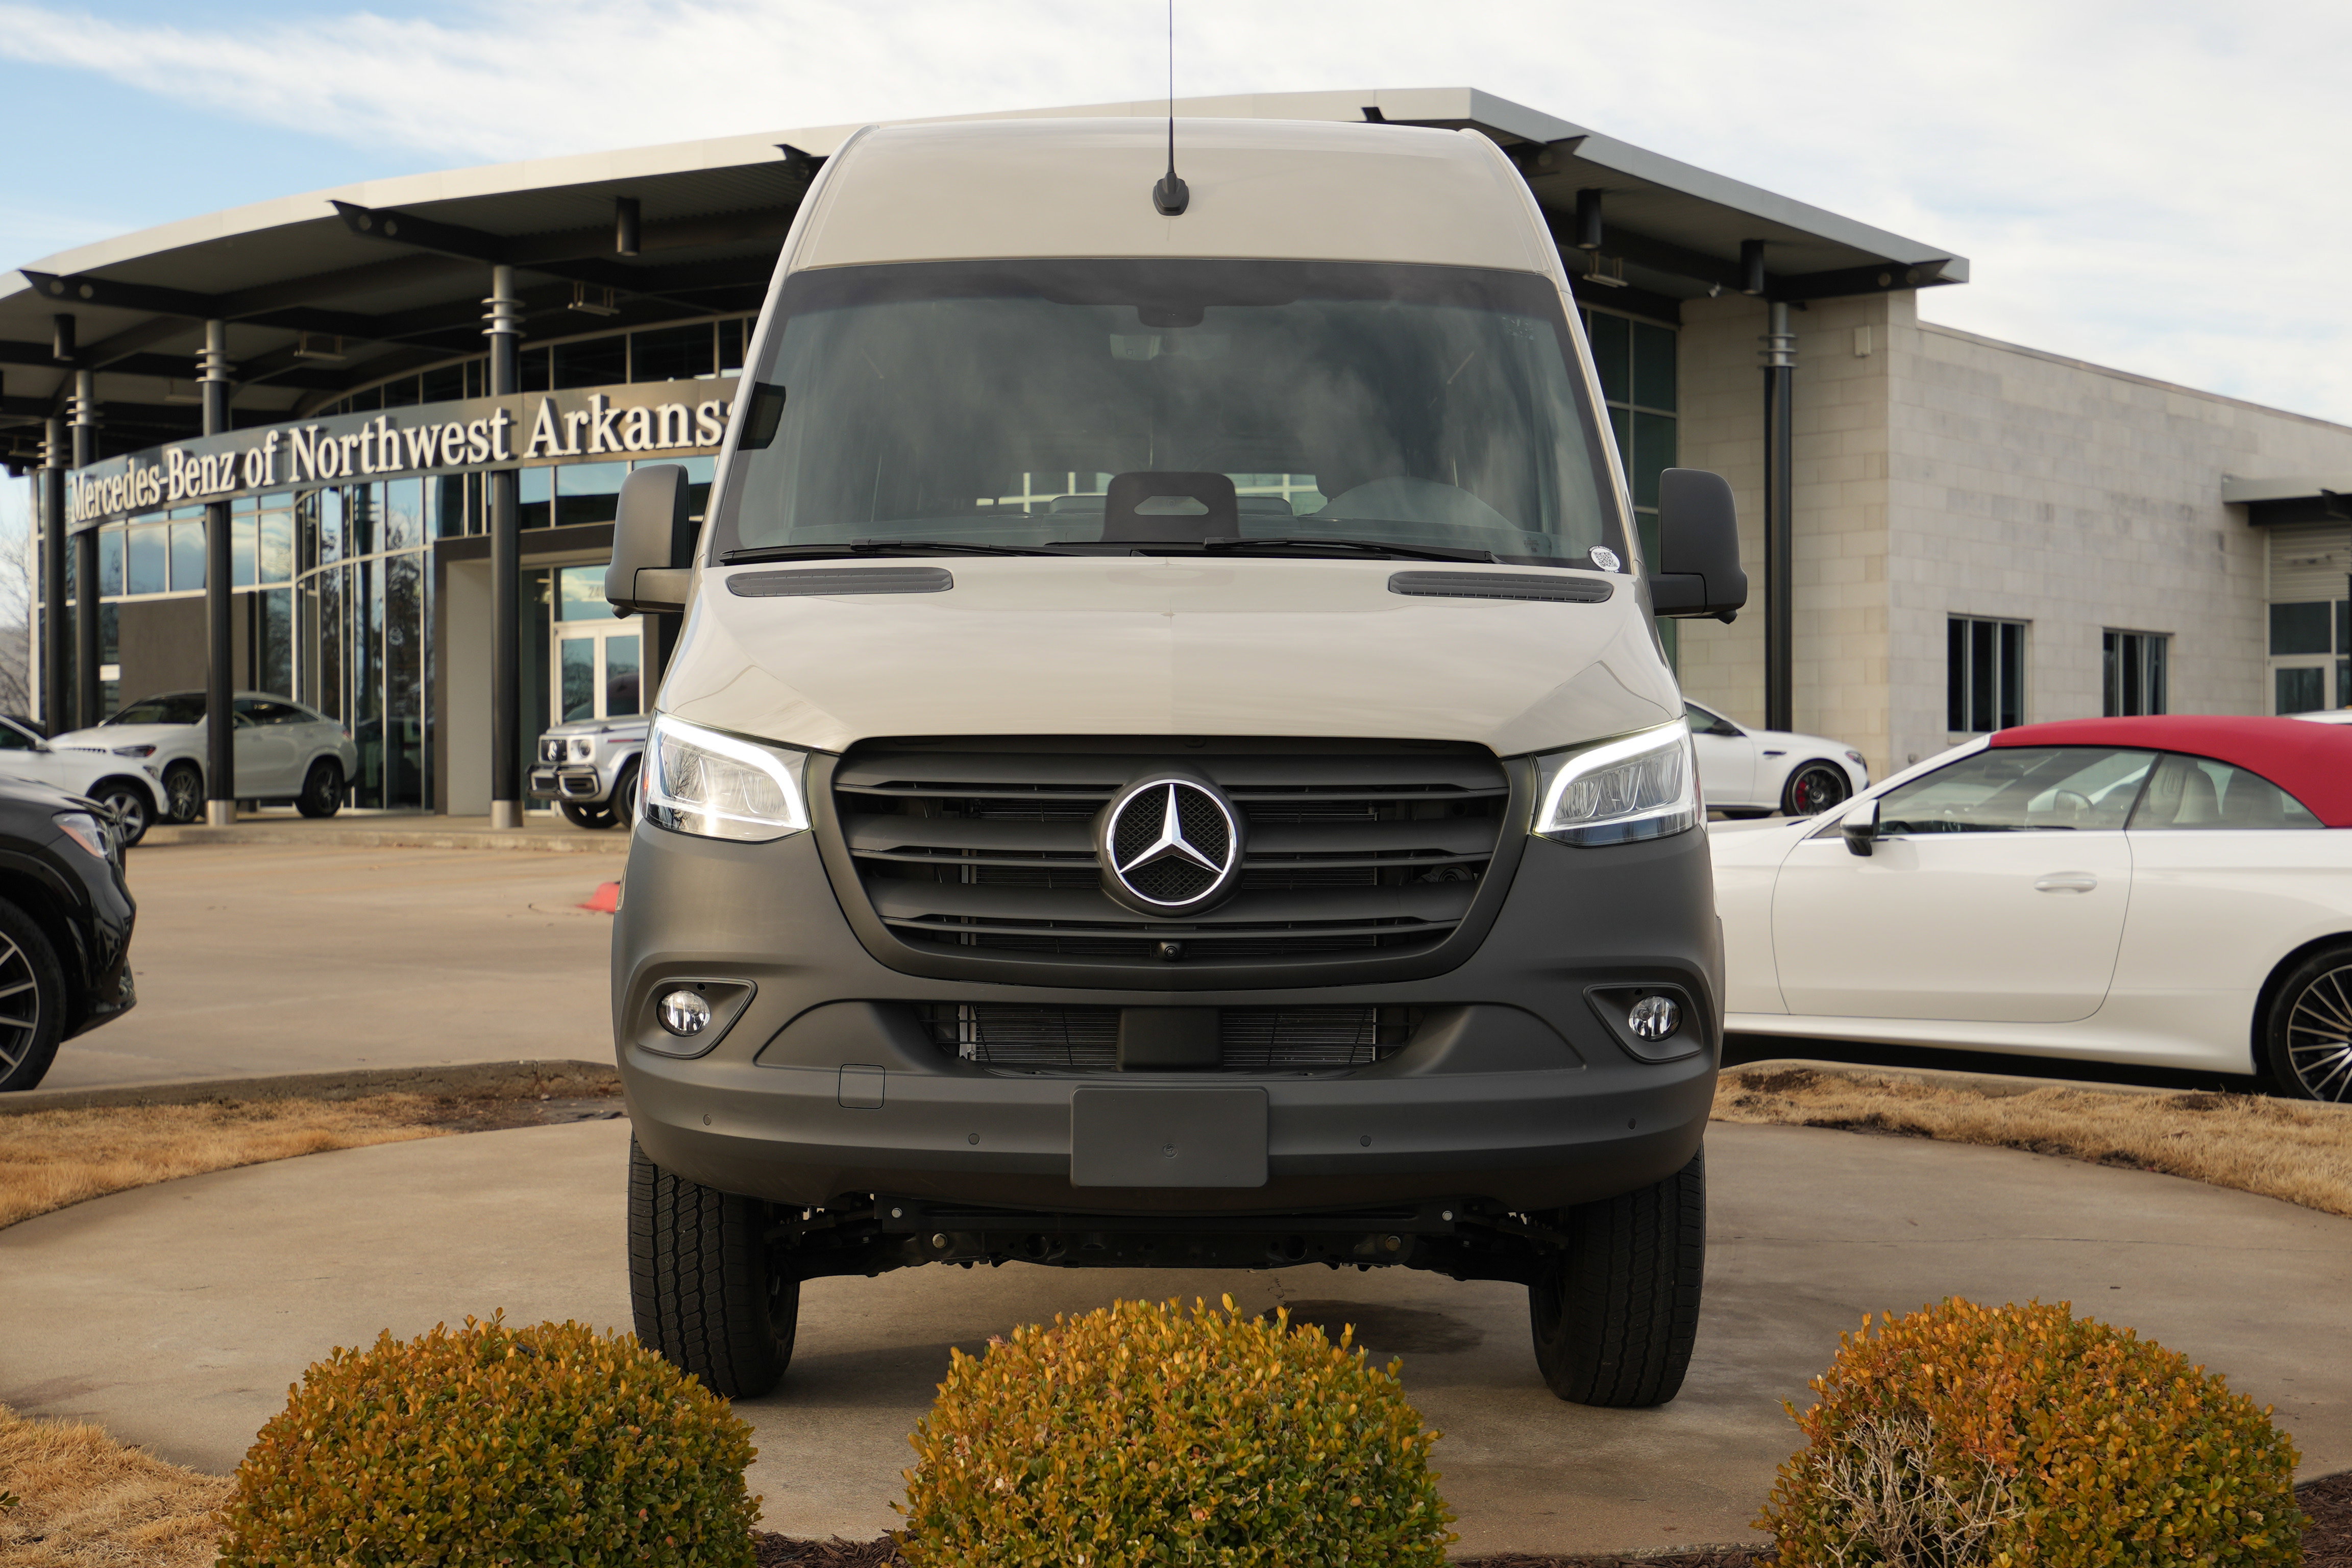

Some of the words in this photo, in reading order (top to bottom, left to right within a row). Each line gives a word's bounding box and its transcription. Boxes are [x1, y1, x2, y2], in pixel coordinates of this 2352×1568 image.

[70, 447, 235, 524] Mercedes-Benz
[244, 430, 279, 488] of
[289, 407, 508, 482] Northwest
[523, 393, 734, 458] Arkans
